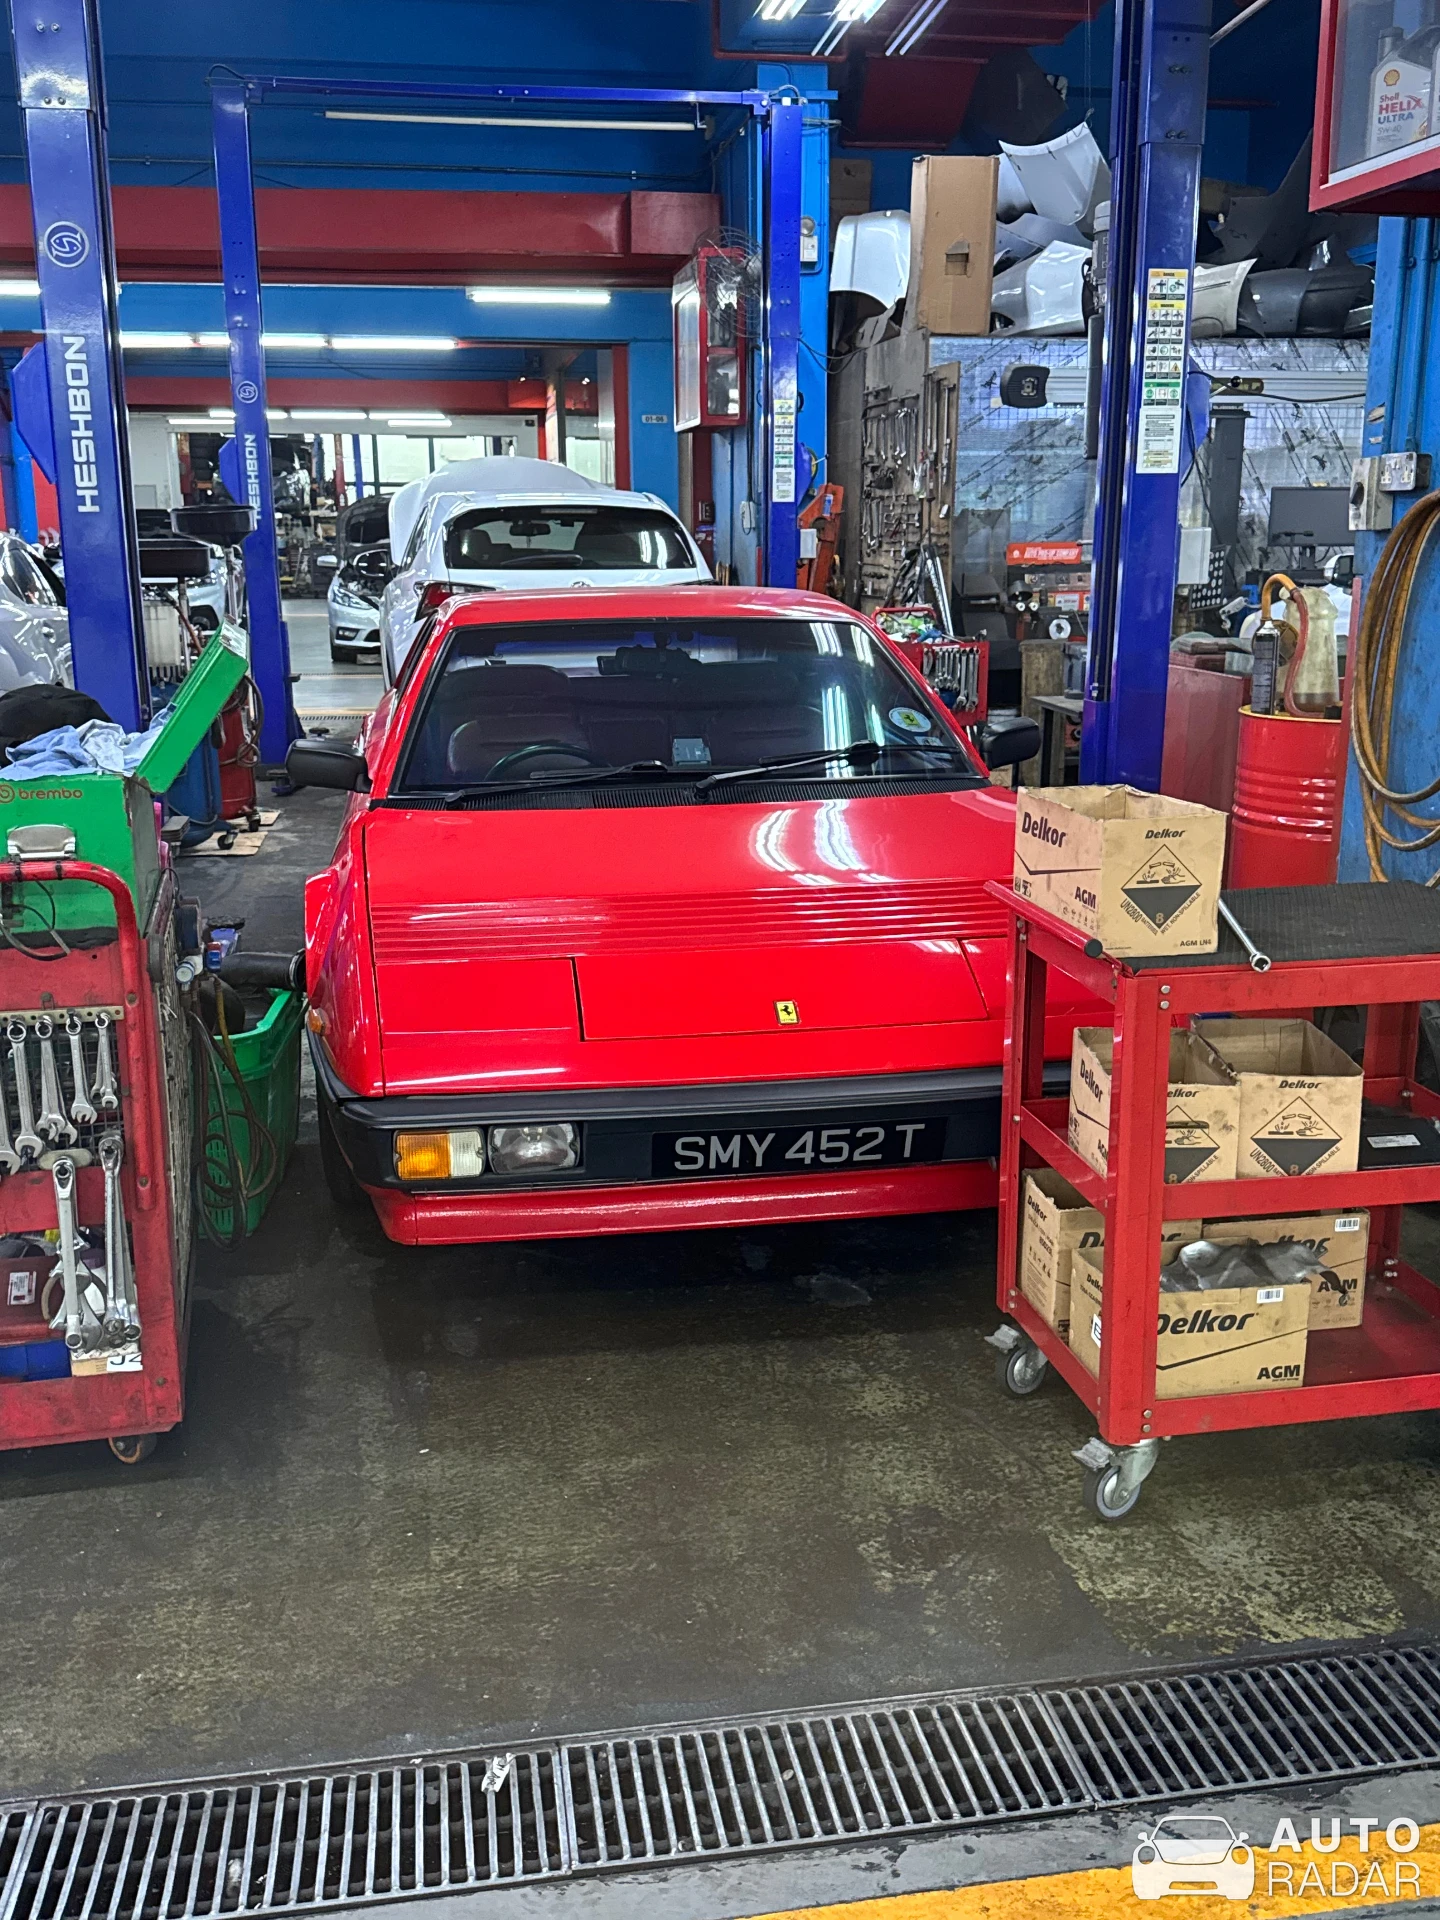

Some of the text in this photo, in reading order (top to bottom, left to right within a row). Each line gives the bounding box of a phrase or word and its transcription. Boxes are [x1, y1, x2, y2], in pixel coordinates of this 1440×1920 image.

[1378, 95, 1424, 115] HELIX
[1380, 92, 1400, 103] Shell
[1377, 111, 1414, 124] ULTRA
[63, 336, 100, 513] HESHBON
[18, 787, 83, 800] brembo
[1021, 811, 1067, 848] Delkor
[1145, 828, 1185, 839] Delkor
[1074, 886, 1097, 909] AGM
[1120, 898, 1143, 923] UN2800
[1155, 912, 1165, 925] 8
[1080, 1058, 1103, 1103] Delkor
[1278, 1080, 1322, 1089] Delkor
[1167, 1088, 1199, 1098] elkor
[674, 1123, 926, 1171] SMY 452 T
[1249, 1147, 1275, 1173] UN2800
[1289, 1164, 1299, 1176] 8
[1027, 1194, 1048, 1222] Delkor
[1086, 1273, 1103, 1293] Delko
[1317, 1278, 1358, 1293] AM
[1157, 1308, 1255, 1335] Delkor
[1256, 1364, 1301, 1380] AGM
